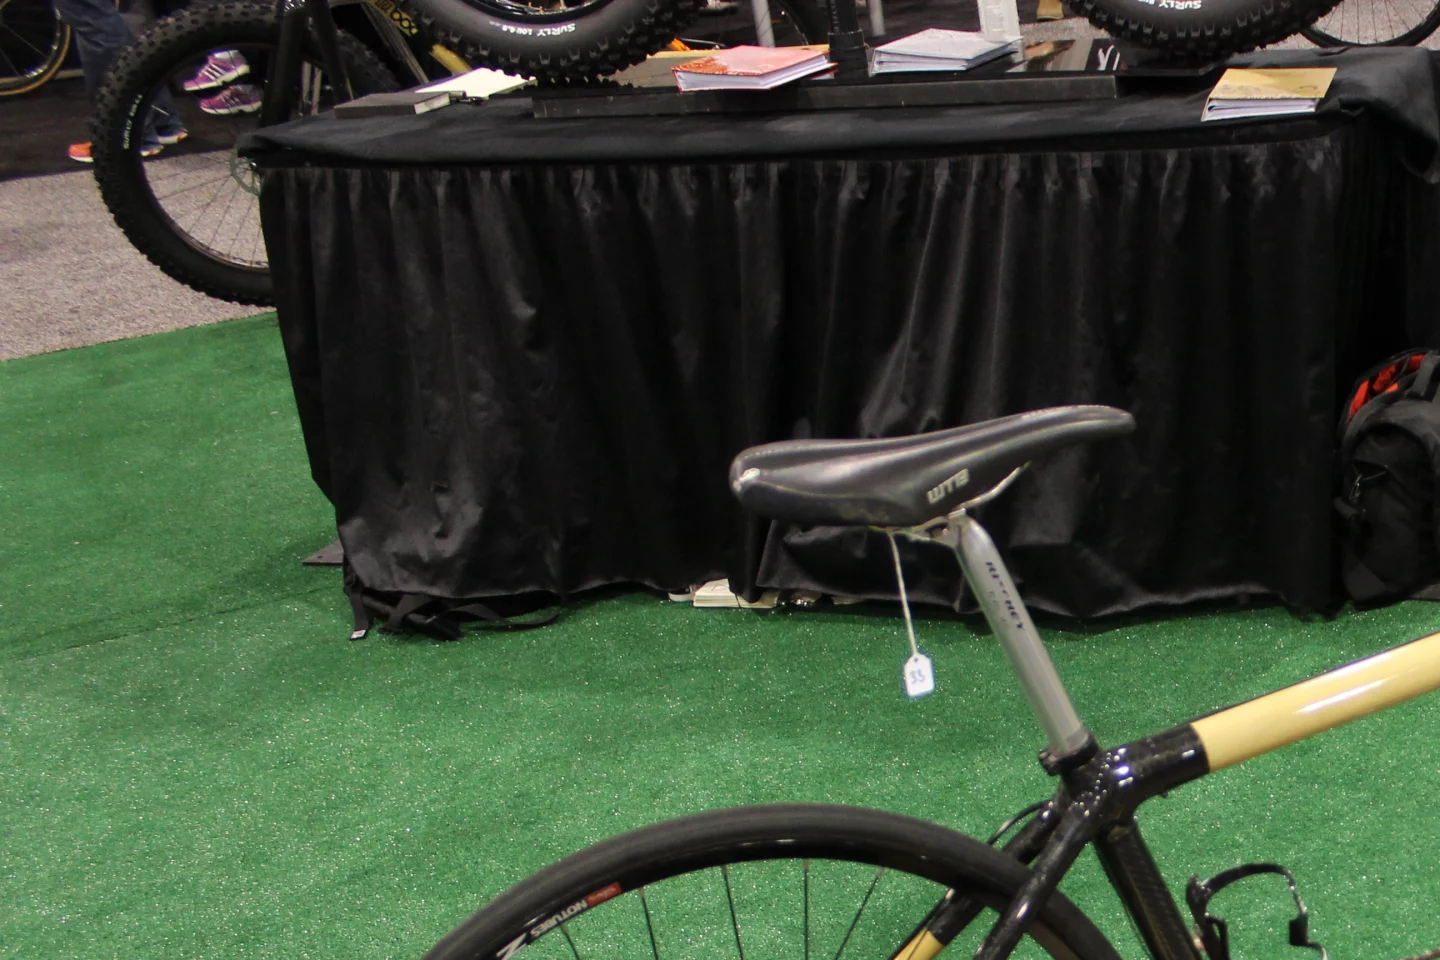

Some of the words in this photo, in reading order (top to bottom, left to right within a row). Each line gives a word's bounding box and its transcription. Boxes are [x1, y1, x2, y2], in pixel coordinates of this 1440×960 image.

[536, 23, 576, 37] SURLY
[926, 468, 970, 504] WTB
[530, 900, 588, 938] NOTUBES
